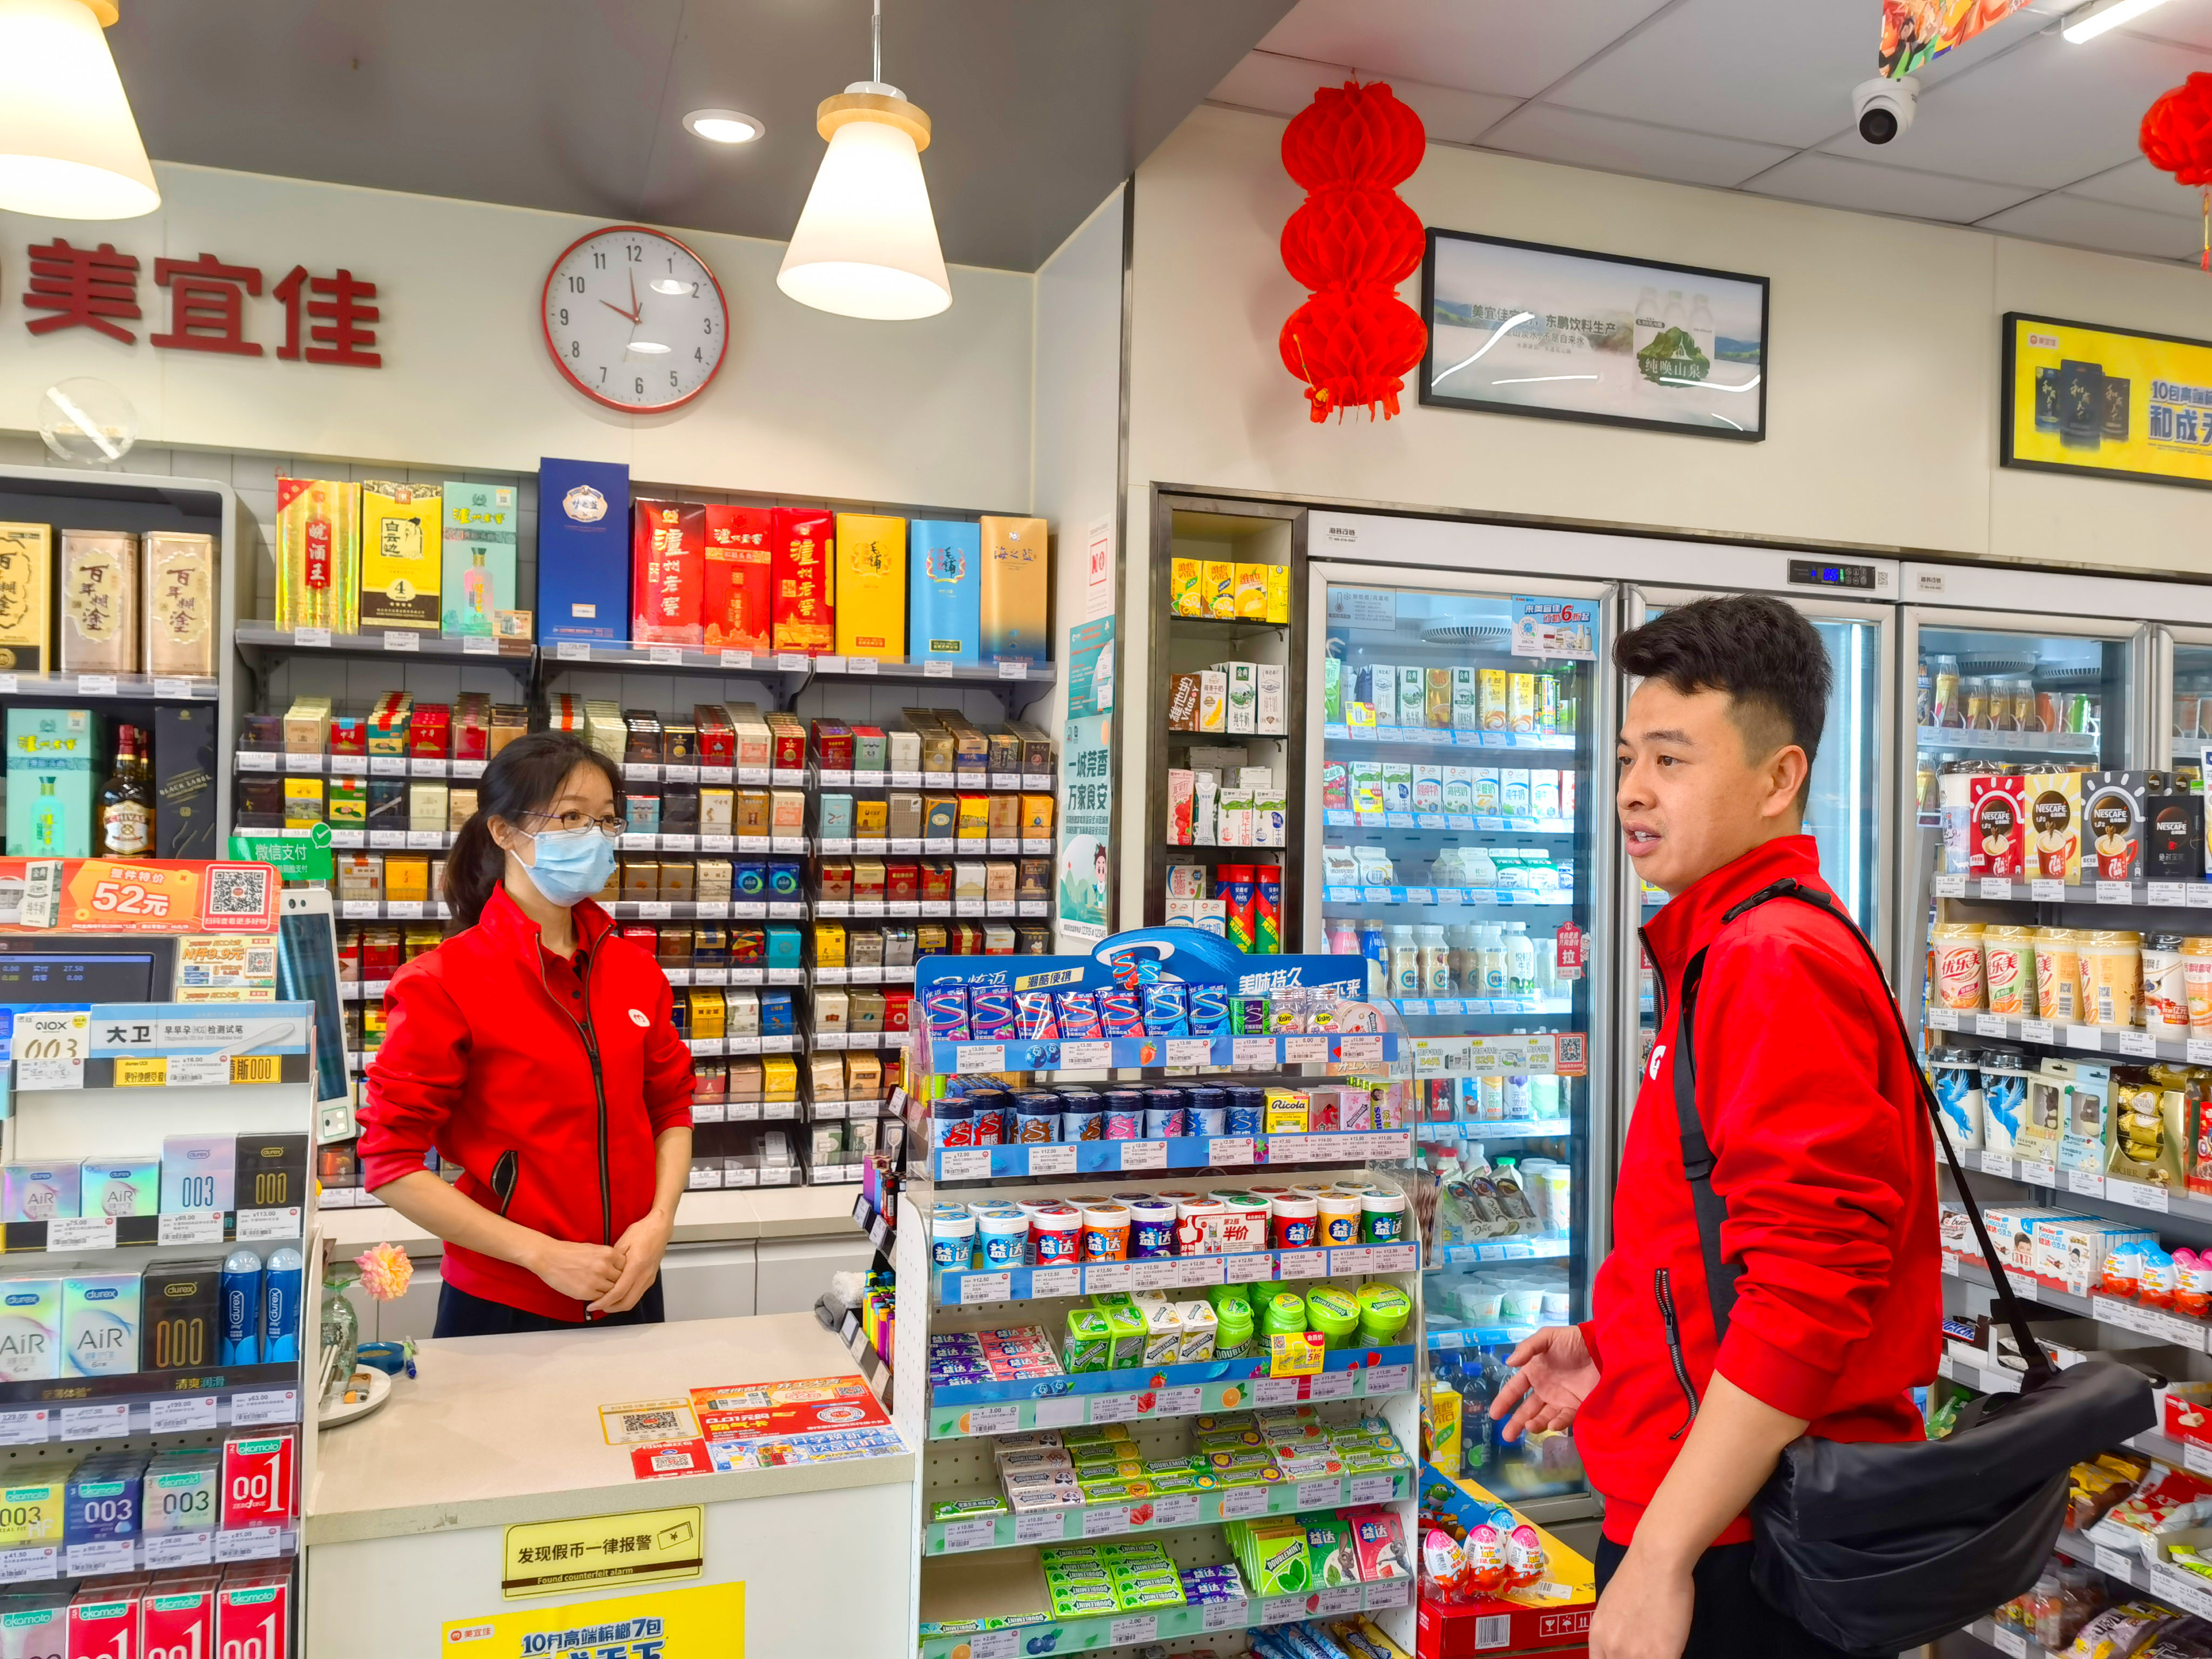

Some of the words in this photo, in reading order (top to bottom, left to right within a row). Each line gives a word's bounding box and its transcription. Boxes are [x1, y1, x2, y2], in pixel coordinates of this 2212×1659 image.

[594, 253, 606, 269] 11
[626, 245, 642, 262] 12
[667, 258, 672, 274] 1
[569, 276, 585, 293] 10
[691, 282, 699, 299] 2
[23, 237, 381, 369] 美宜佳
[560, 309, 569, 325] 9
[704, 318, 711, 334] 3
[572, 341, 580, 358] 8
[694, 347, 703, 363] 4
[599, 367, 607, 383] 7
[670, 371, 678, 387] 5
[635, 377, 643, 394] 6
[384, 521, 400, 554] 白云边
[1091, 550, 1105, 575] NO
[654, 528, 689, 616] 泸州老窖
[790, 539, 819, 617] 泸州老窖
[394, 581, 405, 594] 4
[1237, 667, 1249, 677] 金典
[1069, 749, 1108, 777] 一城莞香
[1068, 783, 1107, 810] 万家食安
[1506, 790, 1525, 800] 纯牛奶
[110, 813, 146, 821] CHIVAS
[1242, 811, 1250, 846] 纯牛奶
[255, 843, 307, 861] 微信支付
[110, 868, 165, 884] 整件特价
[92, 882, 168, 916] 52元
[1562, 949, 1575, 964] 拉
[1942, 950, 1981, 975] 优乐美
[1028, 970, 1072, 988] 潮酷便携
[1238, 967, 1302, 995] 美味持久
[106, 1026, 151, 1043] 大卫
[25, 1038, 78, 1058] 003
[1271, 1100, 1306, 1110] Ricola
[28, 1192, 53, 1205] AiR
[107, 1191, 134, 1203] AiR
[183, 1177, 214, 1208] 003
[1986, 1212, 2001, 1222] Kinder
[1223, 1226, 1249, 1241] 半价
[1289, 1226, 1314, 1241] 益达
[1332, 1224, 1358, 1238] 益达
[1375, 1222, 1402, 1235] 益达
[2039, 1225, 2055, 1235] Kinder
[1040, 1239, 1074, 1254] 益达
[1088, 1238, 1121, 1252] 益达
[1139, 1233, 1171, 1246] 益达
[934, 1245, 969, 1263] 益达
[990, 1242, 1023, 1257] 益达
[85, 1289, 117, 1300] durex
[166, 1284, 196, 1295] durex
[7, 1296, 37, 1305] durex
[232, 1292, 242, 1323] durex
[271, 1289, 281, 1321] durex
[1, 1335, 45, 1354] AiR
[77, 1329, 123, 1350] AiR
[156, 1318, 203, 1367] 001
[1147, 1336, 1179, 1359] DOUBLEMINT
[1182, 1334, 1213, 1357] DOUBLEMINT
[1075, 1342, 1107, 1366] DOUBLEMINT
[943, 1365, 966, 1373] 益达
[1010, 1358, 1033, 1367] 益达
[176, 1377, 225, 1390] 清爽润滑
[239, 1442, 280, 1454] okamoto
[232, 1453, 286, 1513] 001
[1015, 1473, 1049, 1483] DOUBLEMINT
[163, 1490, 210, 1514] 003
[1022, 1493, 1056, 1502] DOUBLEMINT
[84, 1500, 132, 1522] 003
[1309, 1531, 1336, 1545] 益达
[1362, 1525, 1388, 1539] 益达
[518, 1535, 651, 1564] 发现假币一律报警
[1267, 1542, 1302, 1570] DOUBLEMINT
[538, 1575, 563, 1584] Found
[565, 1569, 609, 1581] counterfeit
[610, 1567, 633, 1576] alarm
[156, 1596, 200, 1609] okamoto
[231, 1590, 275, 1603] okamoto
[1142, 1591, 1178, 1601] DOUBLEMINT
[82, 1605, 127, 1618] okamoto
[1076, 1600, 1112, 1610] DOUBLEMINT
[5, 1613, 51, 1626] okamoto
[1008, 1614, 1044, 1624] DOUBLEMINT
[464, 1628, 491, 1638] 美宜佳
